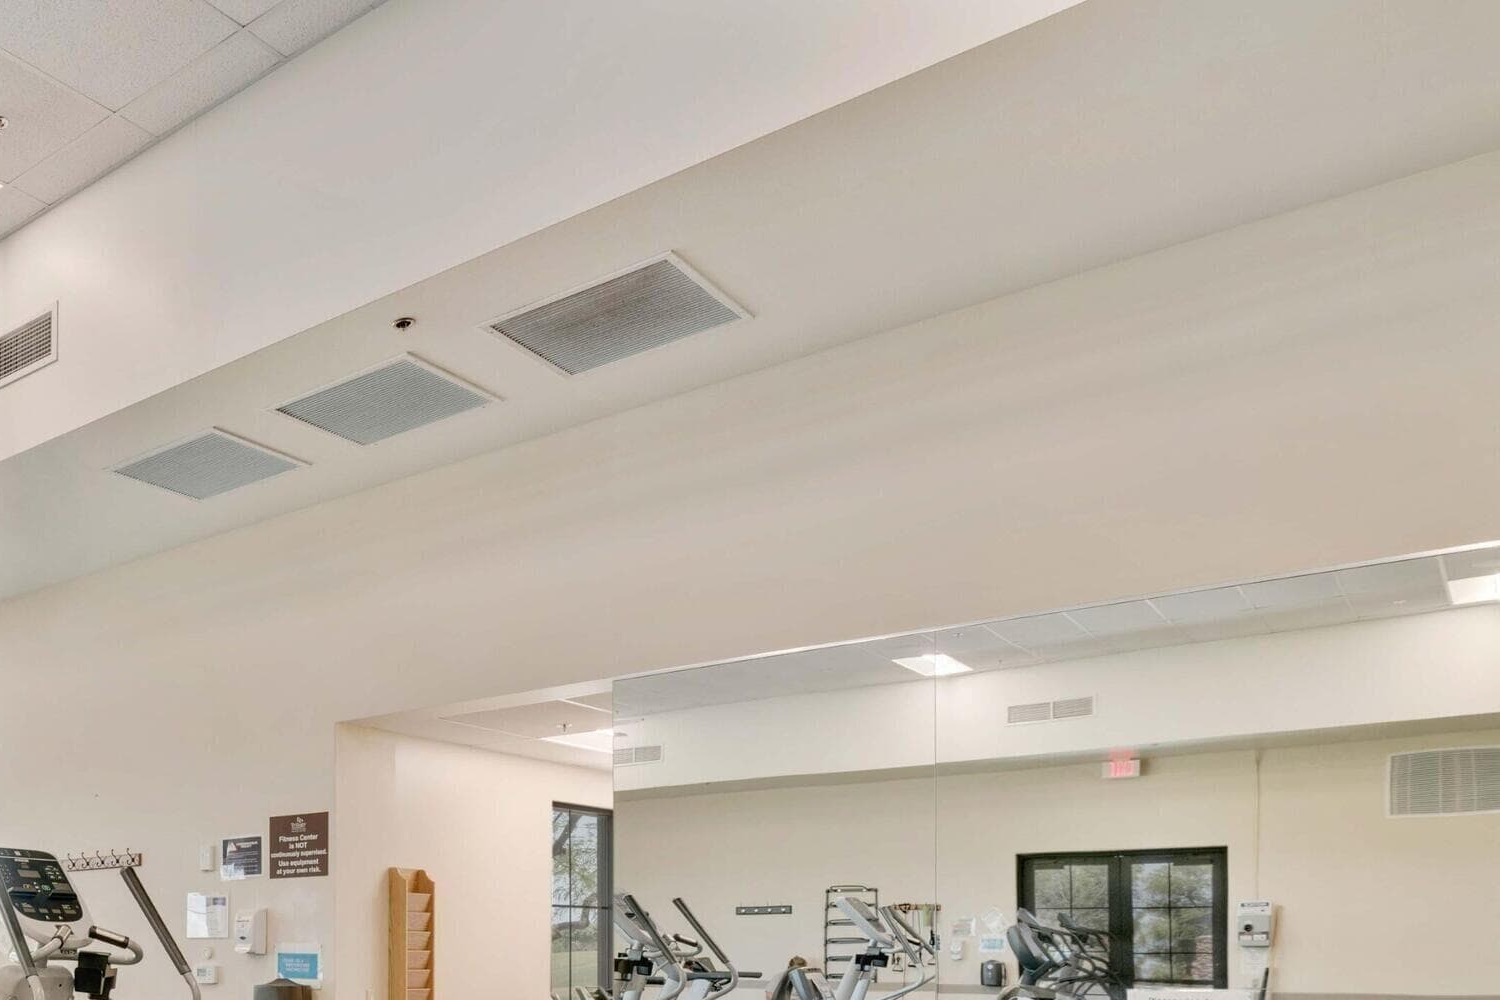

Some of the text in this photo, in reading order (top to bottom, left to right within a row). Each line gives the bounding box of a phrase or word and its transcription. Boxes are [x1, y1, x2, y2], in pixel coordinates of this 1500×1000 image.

[278, 833, 319, 843] Fitness Center
[295, 841, 308, 849] NOT
[290, 858, 319, 868] equipment
